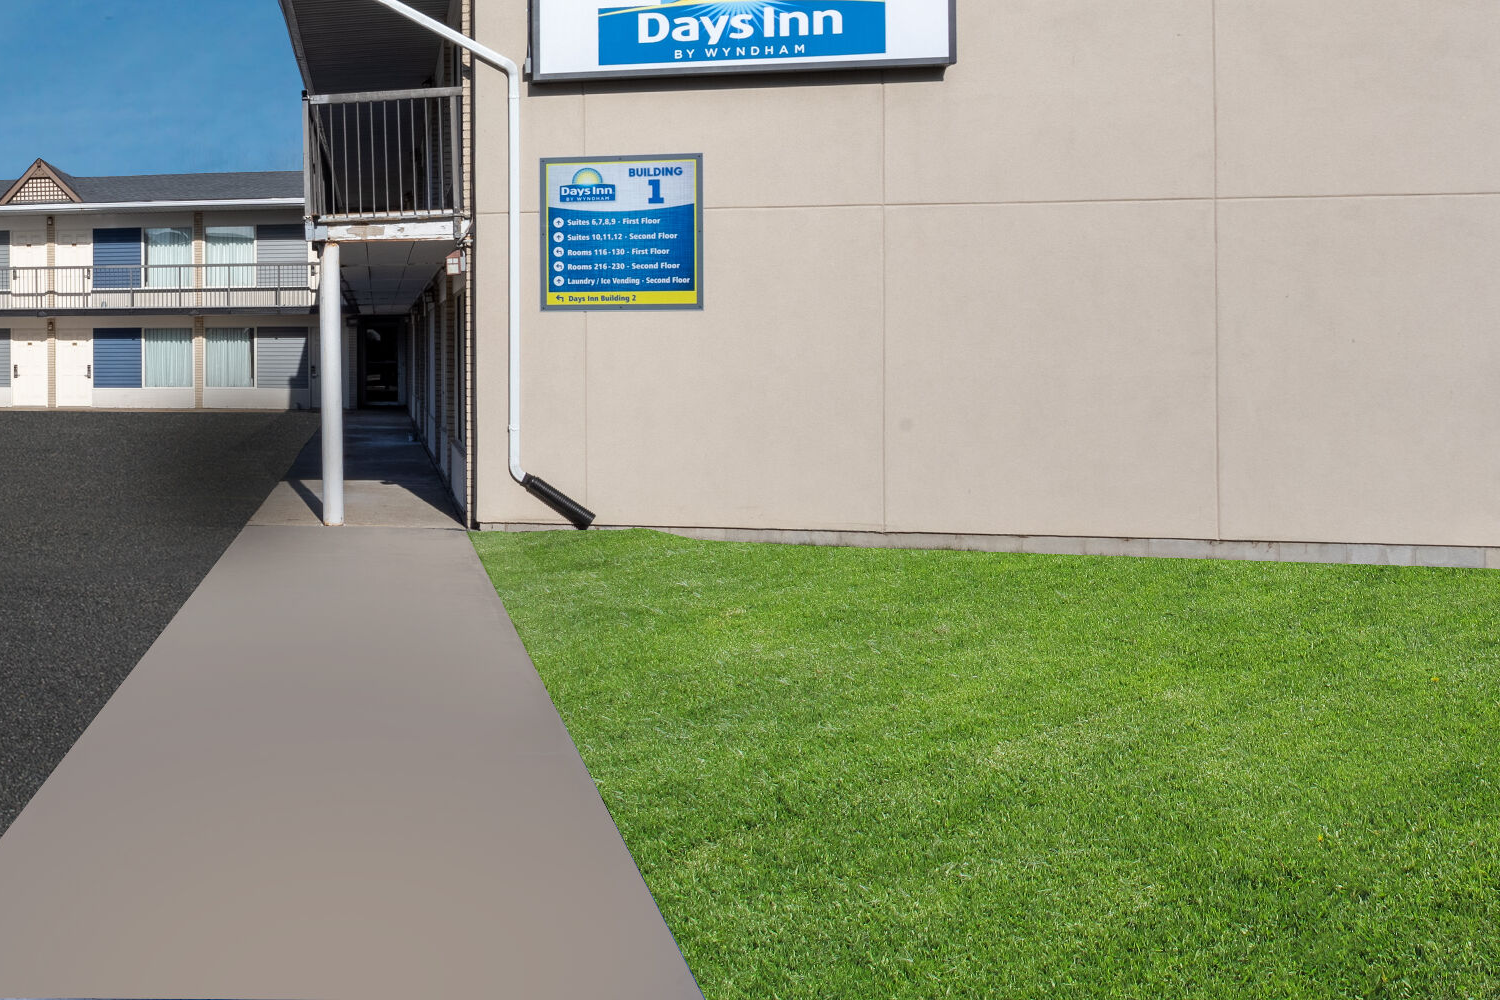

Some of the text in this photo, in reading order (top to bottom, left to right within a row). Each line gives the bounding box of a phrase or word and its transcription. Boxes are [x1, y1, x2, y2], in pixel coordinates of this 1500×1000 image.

[638, 6, 843, 45] Days Inn
[674, 44, 805, 60] BY WYNDHAM
[628, 166, 683, 177] BUILDING
[561, 186, 613, 196] Days Inn
[648, 179, 664, 204] 1
[567, 218, 590, 226] Suites
[567, 278, 595, 286] Laundry
[612, 277, 640, 286] Vending
[672, 276, 691, 284] Floor
[568, 295, 586, 303] Days
[601, 294, 630, 303] Building
